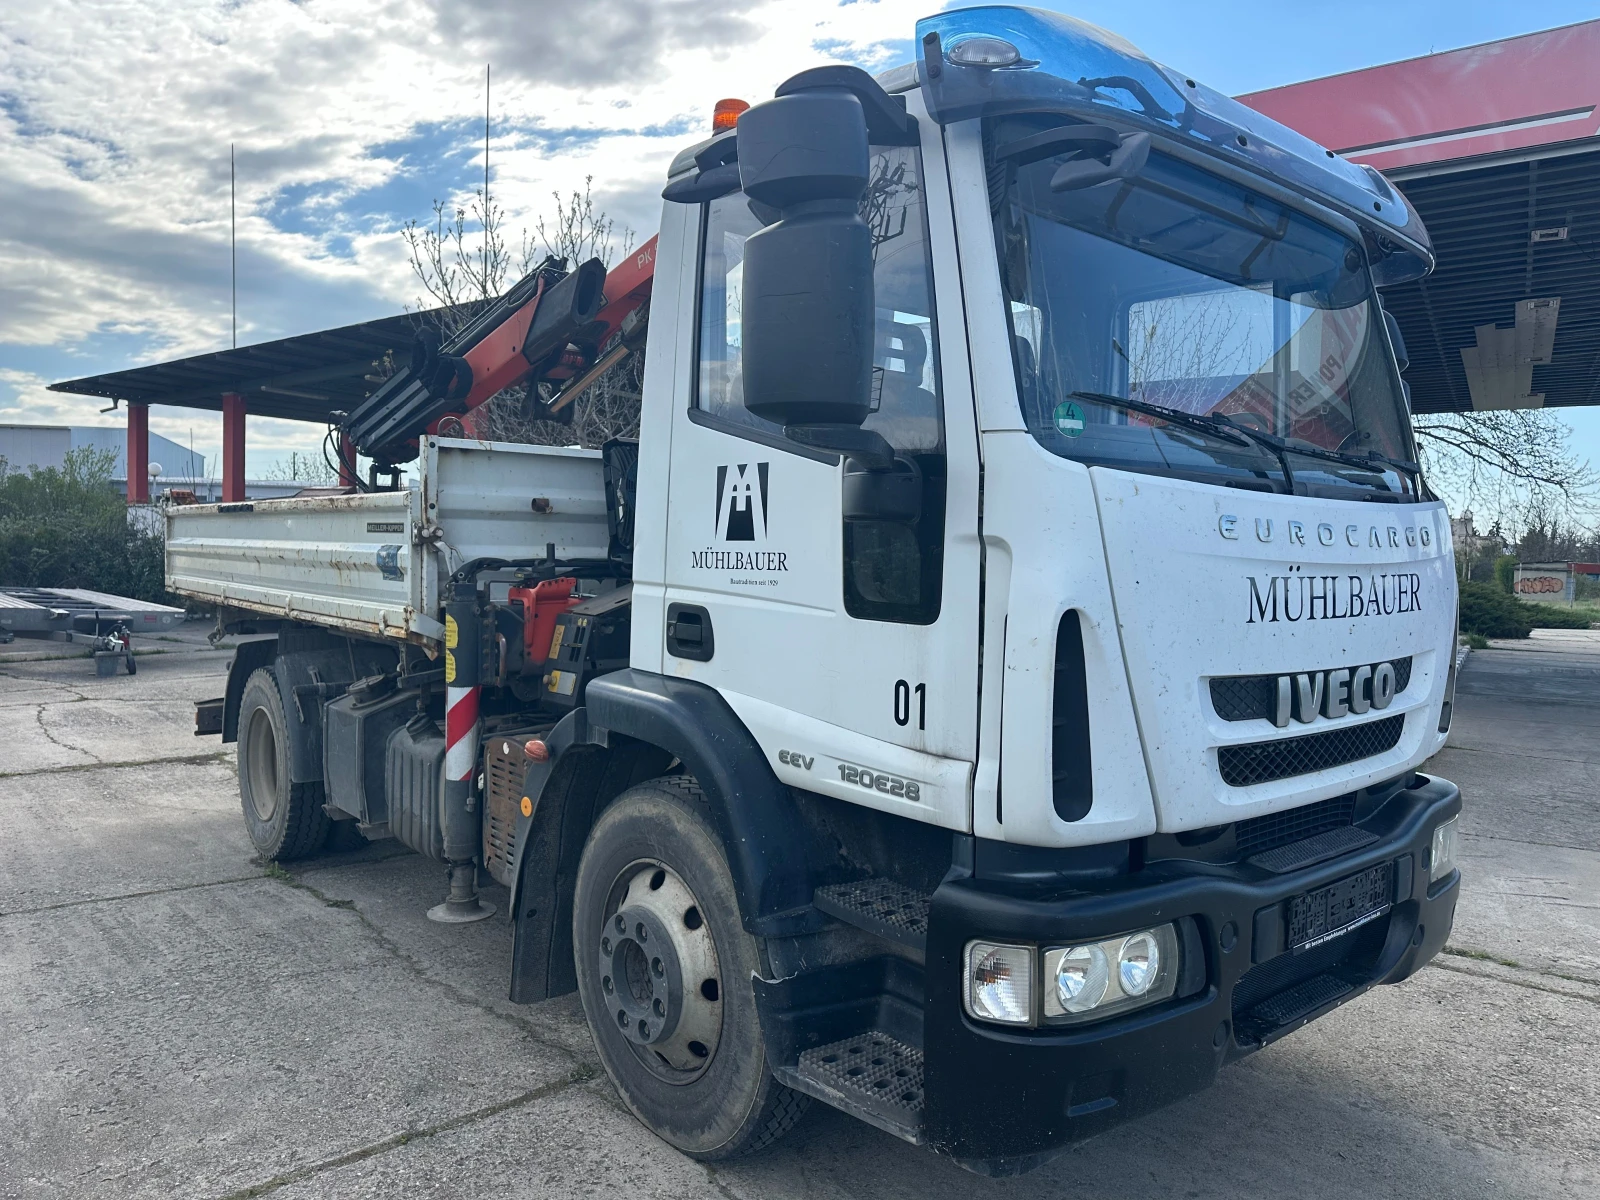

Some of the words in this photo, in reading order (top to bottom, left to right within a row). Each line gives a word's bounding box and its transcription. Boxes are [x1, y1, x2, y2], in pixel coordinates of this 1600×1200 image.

[637, 248, 653, 270] PK
[1065, 403, 1076, 420] 4
[367, 524, 404, 532] MEILLER-KIPPER
[1218, 514, 1432, 548] EUROCARGO
[691, 546, 789, 572] MÜHLBAUER
[767, 579, 779, 587] 1929
[1245, 565, 1422, 624] MÜHLBAUER
[894, 678, 926, 731] 01
[1276, 662, 1396, 728] IVECO
[778, 749, 815, 771] EEV
[837, 763, 921, 802] 120E28
